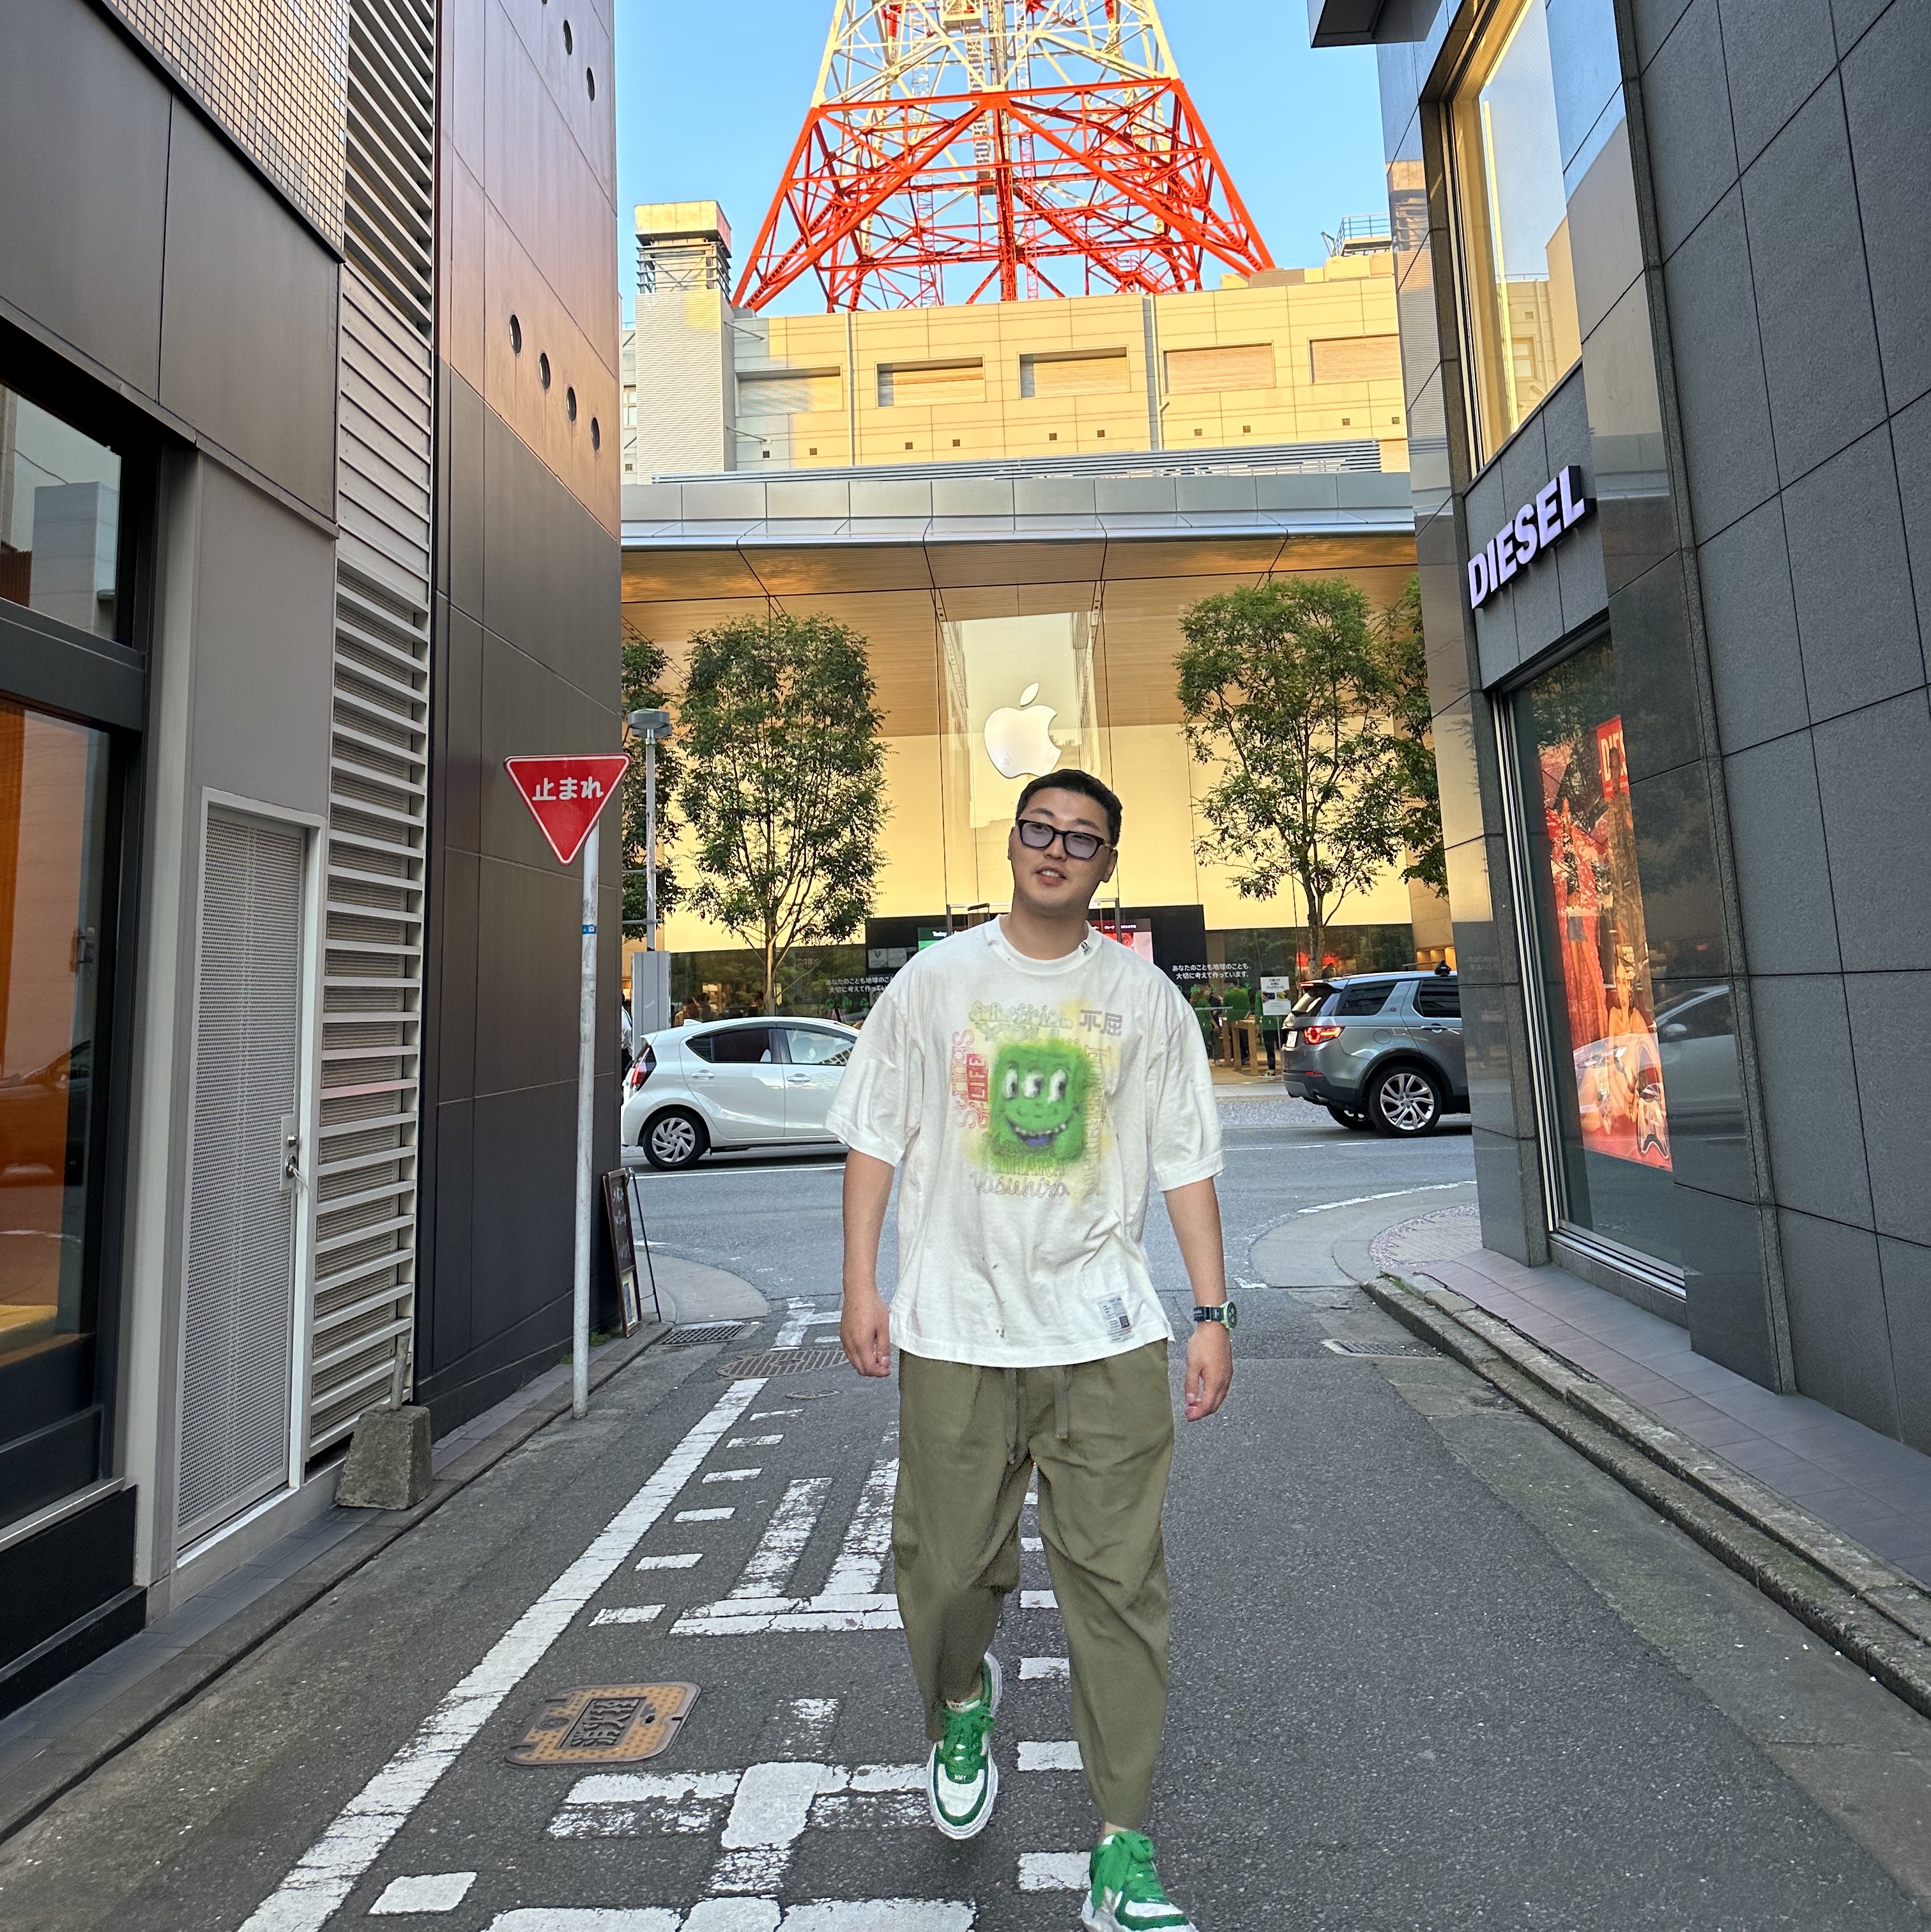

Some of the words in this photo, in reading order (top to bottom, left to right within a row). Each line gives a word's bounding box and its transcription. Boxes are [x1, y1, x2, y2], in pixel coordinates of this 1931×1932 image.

[1467, 465, 1587, 610] DIESEL
[531, 776, 604, 801] 止まれ
[968, 1054, 988, 1100] LIFE
